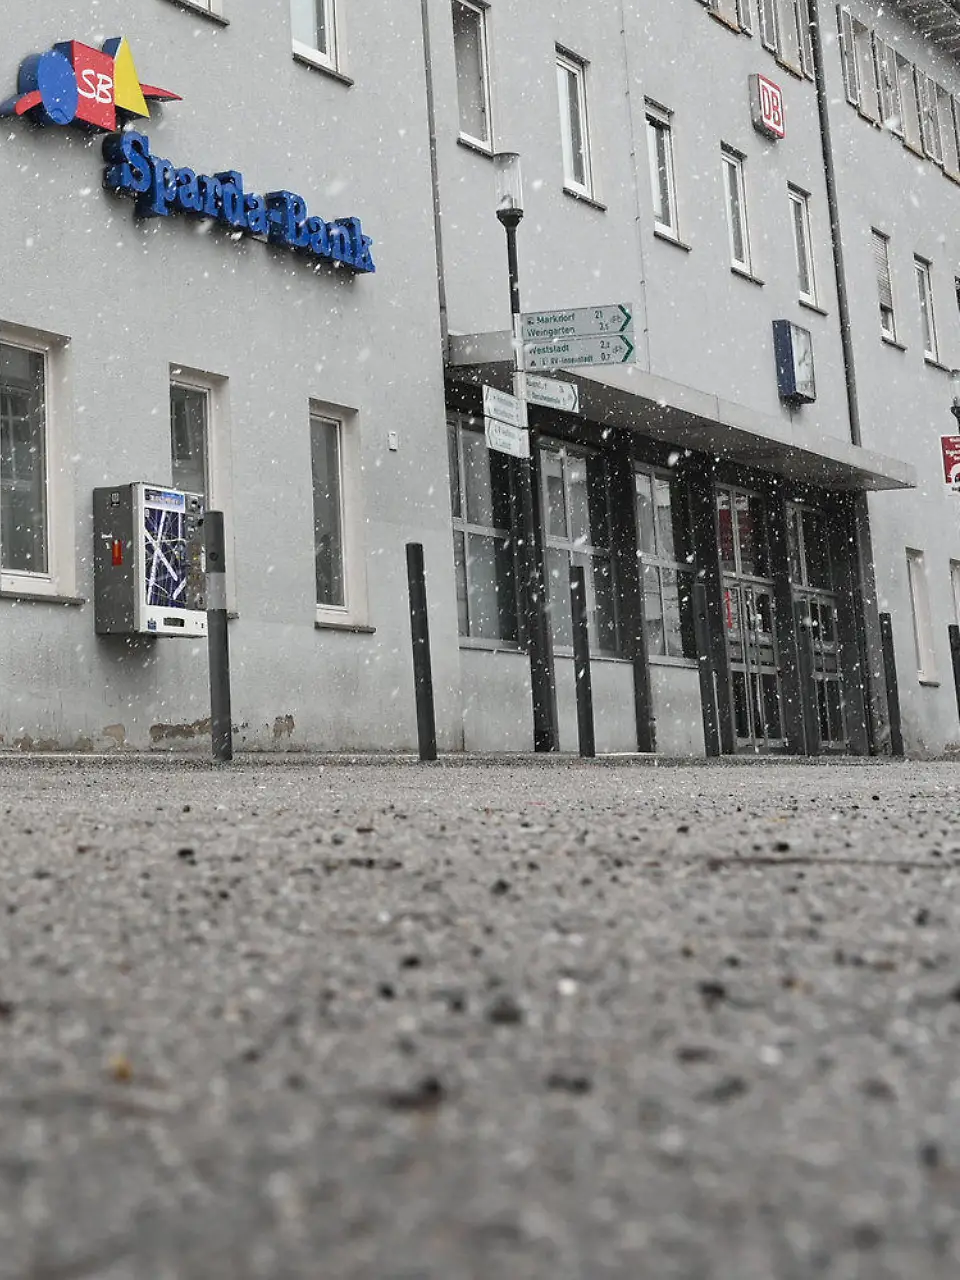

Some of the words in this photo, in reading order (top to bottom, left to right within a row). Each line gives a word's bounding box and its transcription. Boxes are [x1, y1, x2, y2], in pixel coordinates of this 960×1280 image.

[77, 69, 113, 104] SB
[762, 85, 781, 126] DB
[104, 131, 376, 273] Sparda-Bank
[527, 326, 576, 338] Weingarten
[537, 313, 575, 324] Markdorf
